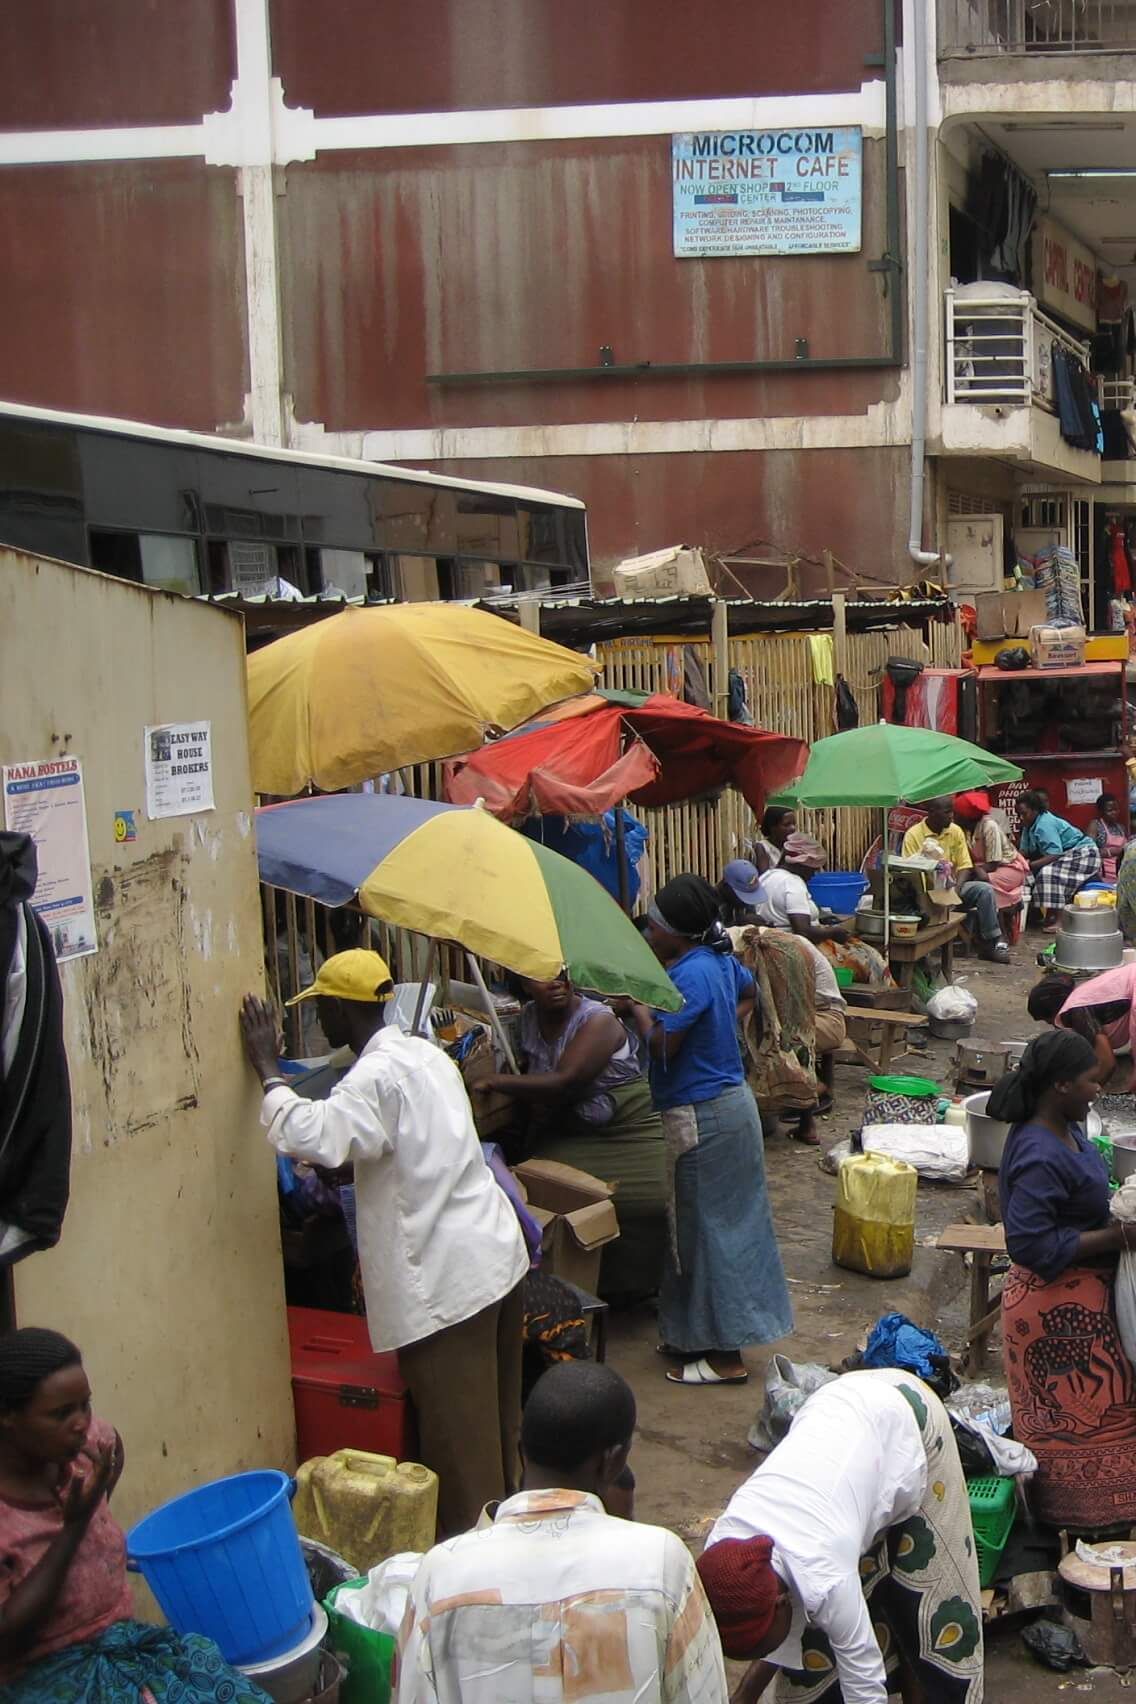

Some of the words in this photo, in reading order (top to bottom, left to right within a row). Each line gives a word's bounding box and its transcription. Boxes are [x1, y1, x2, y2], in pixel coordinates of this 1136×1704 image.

[692, 132, 833, 156] MICROCOM
[676, 157, 778, 180] INTERNET
[796, 156, 849, 177] CAFE
[680, 184, 706, 195] NOW
[708, 183, 737, 194] OPEN
[740, 183, 769, 193] SHOP
[803, 181, 839, 191] FLOOR
[740, 193, 777, 202] CENTER
[767, 232, 783, 240] AND
[171, 733, 190, 745] EASY
[191, 731, 208, 742] WAY
[177, 747, 203, 759] HOUSE
[8, 766, 36, 780] NANA
[171, 762, 209, 776] BROKERS
